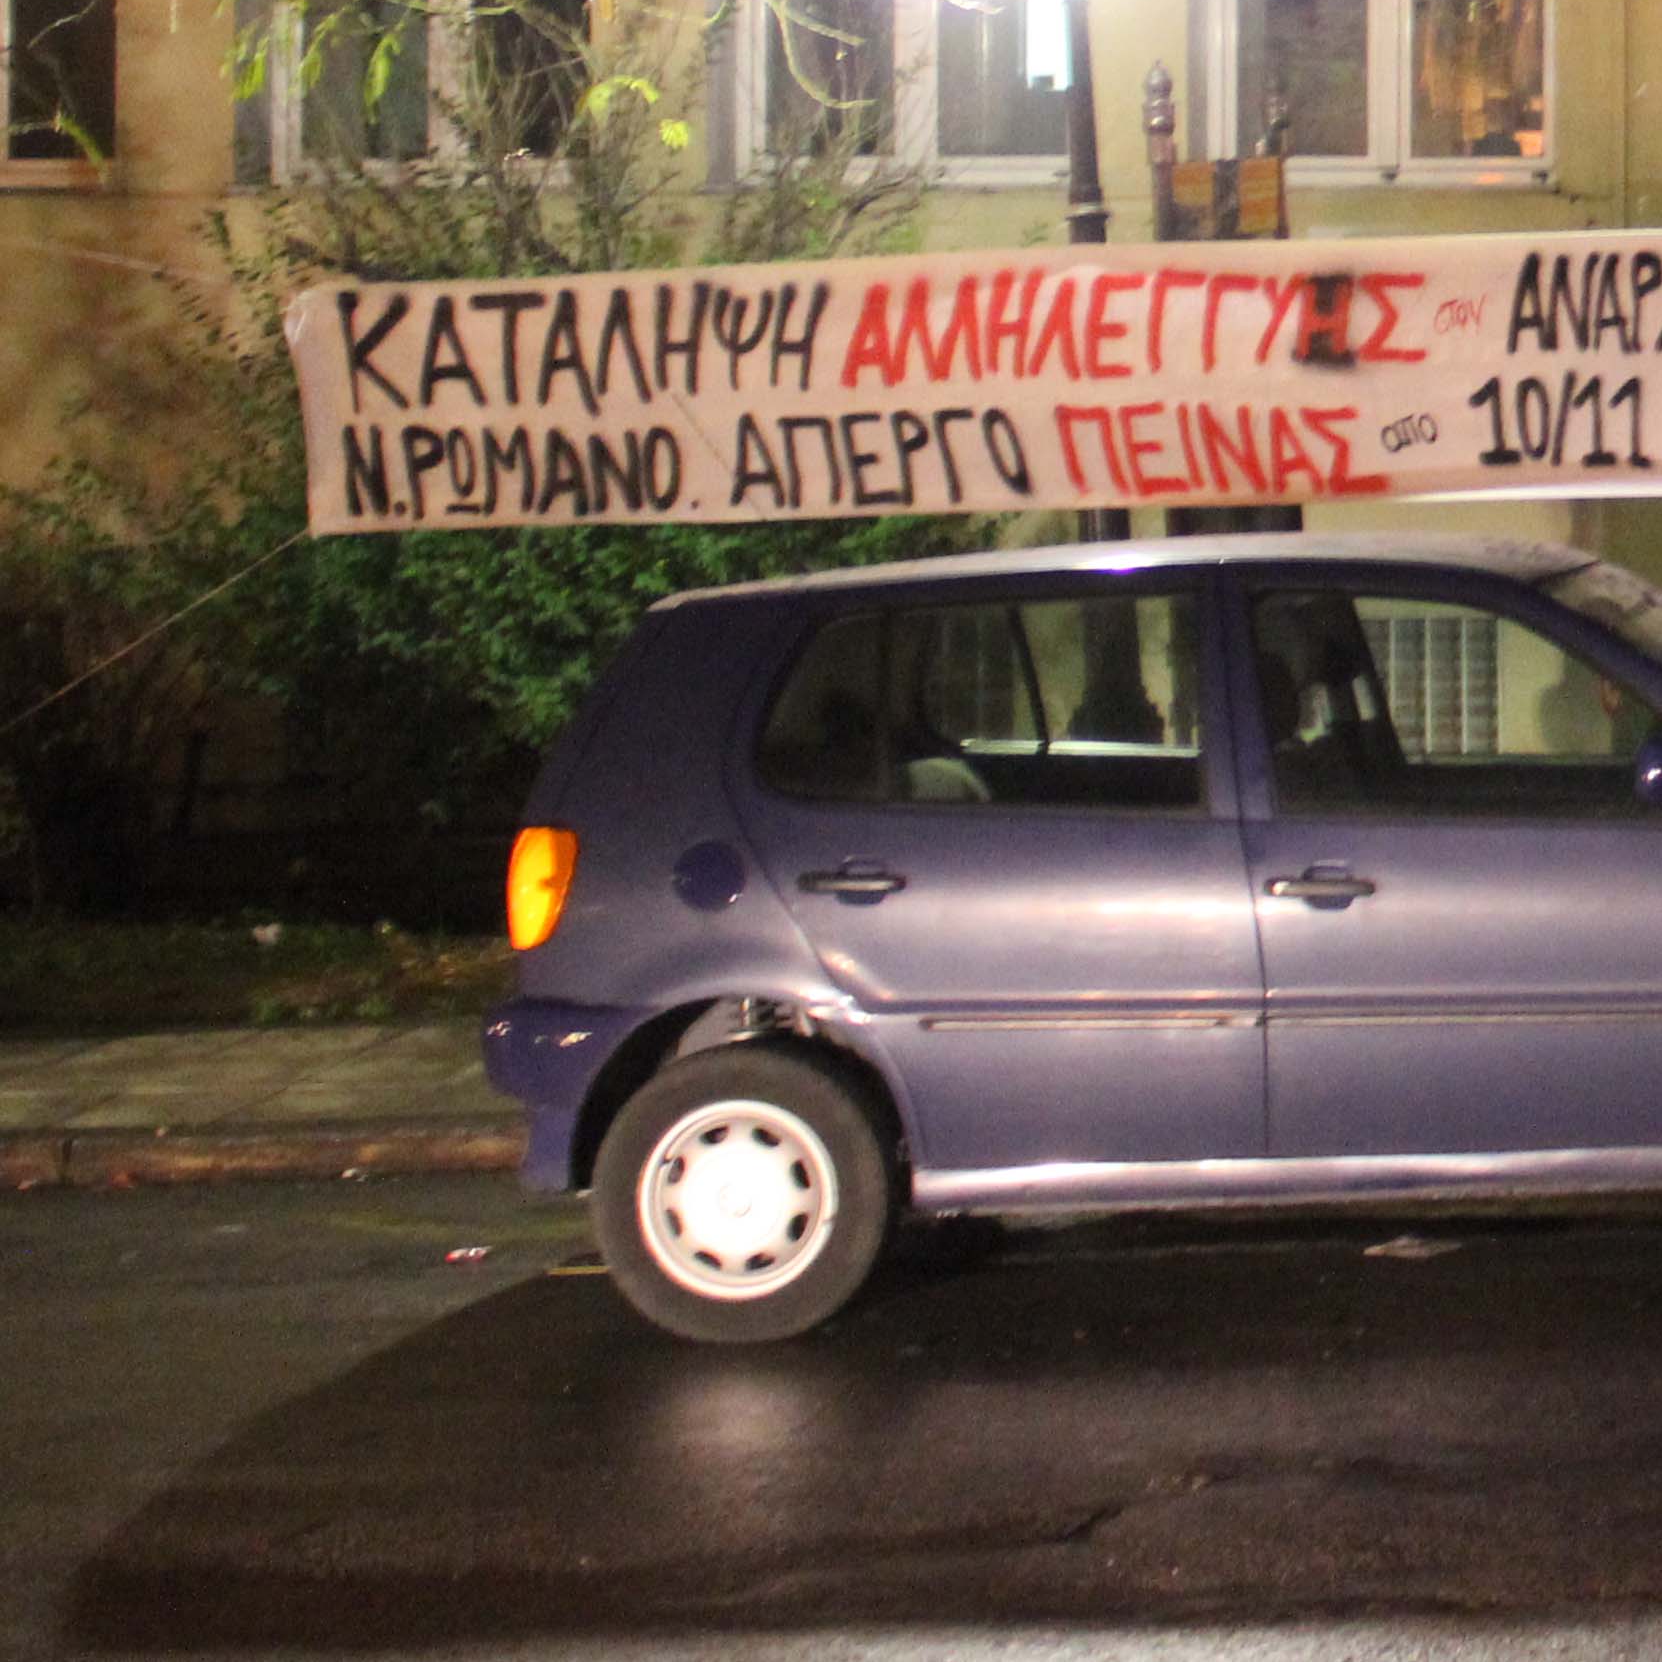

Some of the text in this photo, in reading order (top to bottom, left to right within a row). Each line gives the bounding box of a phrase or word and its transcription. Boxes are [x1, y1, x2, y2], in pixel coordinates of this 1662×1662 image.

[338, 282, 832, 416] ΚΑΤΑΛΗΨΗ
[730, 408, 1034, 508] ΑΠΕΡΓΟ
[1054, 400, 1392, 496] ΠΕΙΝΑΣ
[1468, 370, 1652, 468] 10/11
